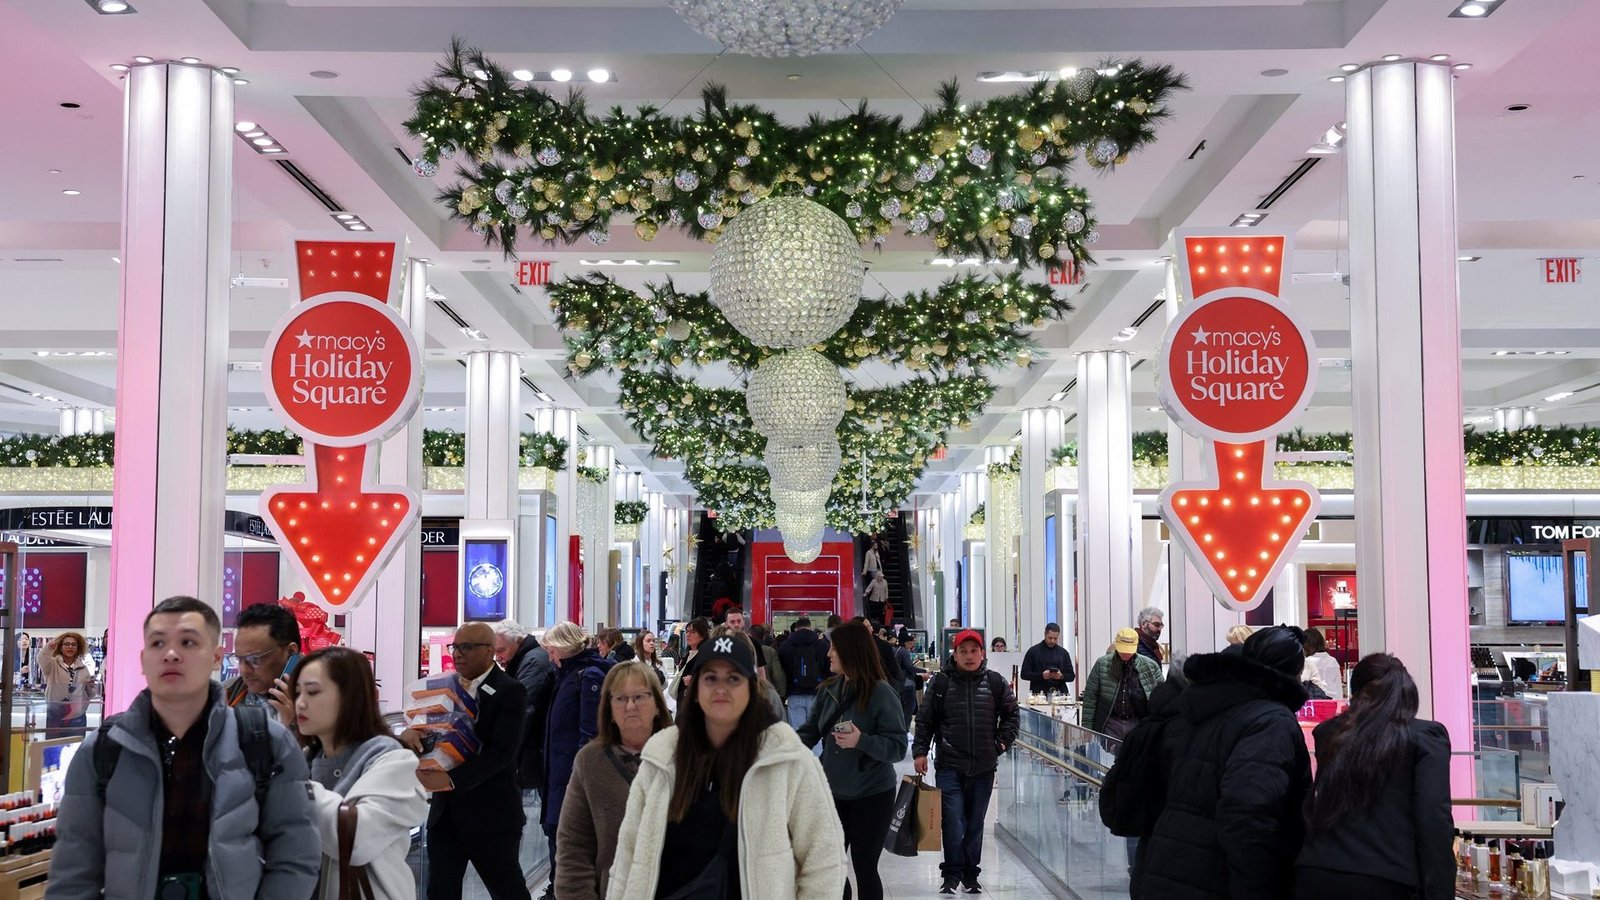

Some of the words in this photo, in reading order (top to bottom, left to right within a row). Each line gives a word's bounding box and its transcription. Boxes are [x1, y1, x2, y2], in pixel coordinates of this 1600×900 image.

[520, 262, 550, 285] EXIT
[1546, 259, 1577, 282] EXIT
[317, 330, 386, 354] macy's
[1213, 325, 1281, 350] macy's
[289, 353, 394, 385] Holiday
[1187, 349, 1290, 380] Holiday
[292, 379, 387, 410] Square
[1190, 375, 1285, 407] Square
[78, 511, 113, 526] LAU
[1531, 525, 1570, 539] TOM
[713, 637, 733, 653] NY
